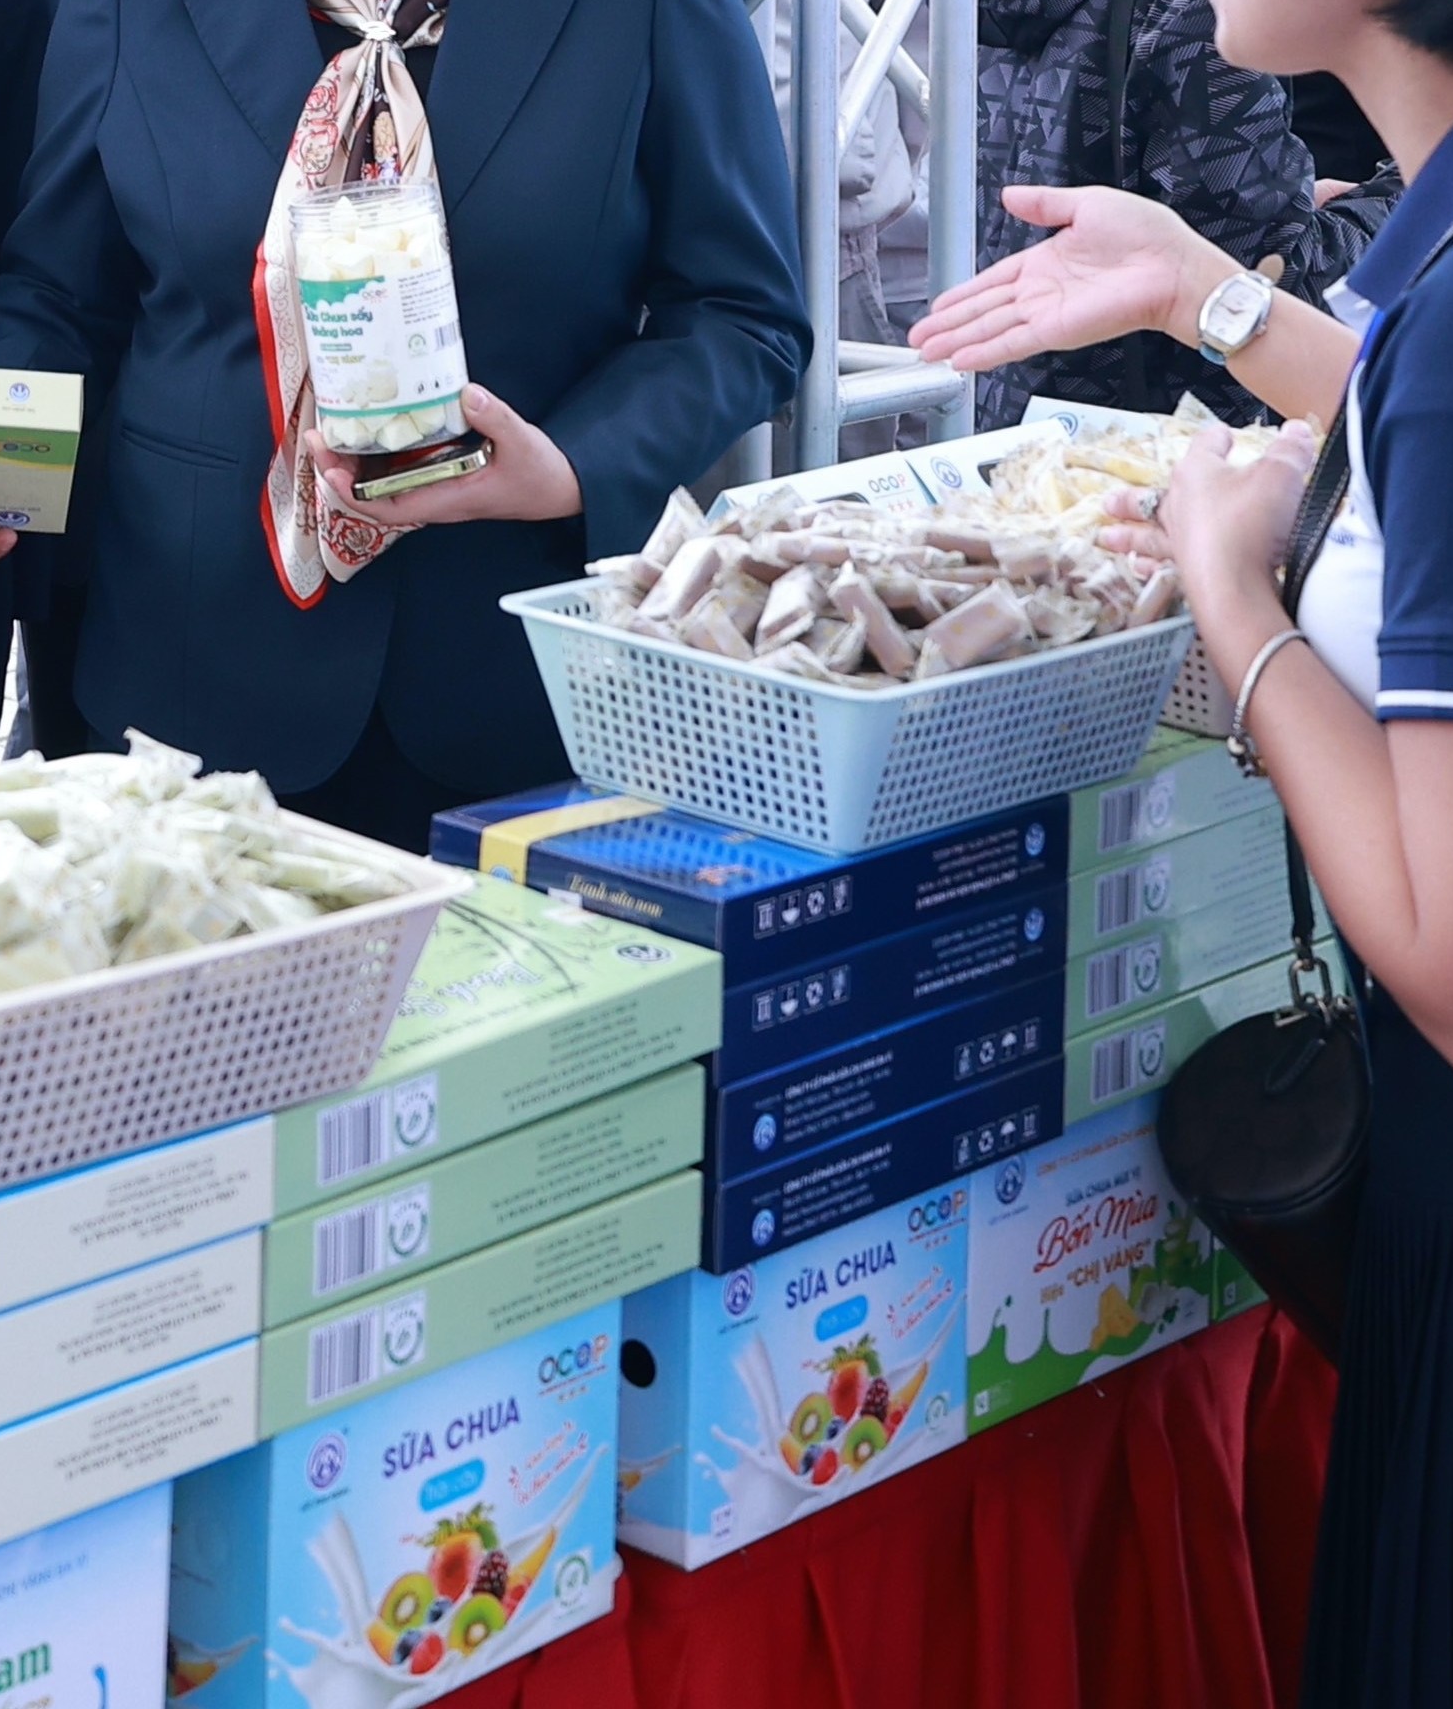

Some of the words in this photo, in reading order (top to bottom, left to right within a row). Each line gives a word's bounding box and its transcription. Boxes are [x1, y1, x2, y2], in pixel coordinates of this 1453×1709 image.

[341, 325, 364, 337] hoa
[351, 305, 373, 323] sấy
[868, 471, 906, 493] OCOP
[907, 1188, 967, 1233] OCOP
[1033, 1204, 1094, 1274] Bốn
[1094, 1189, 1160, 1240] Mùa
[785, 1266, 829, 1310] SỮA
[835, 1239, 897, 1288] CHUA
[538, 1333, 611, 1384] OCOP
[383, 1431, 436, 1479] SỮA
[446, 1395, 521, 1450] CHUA
